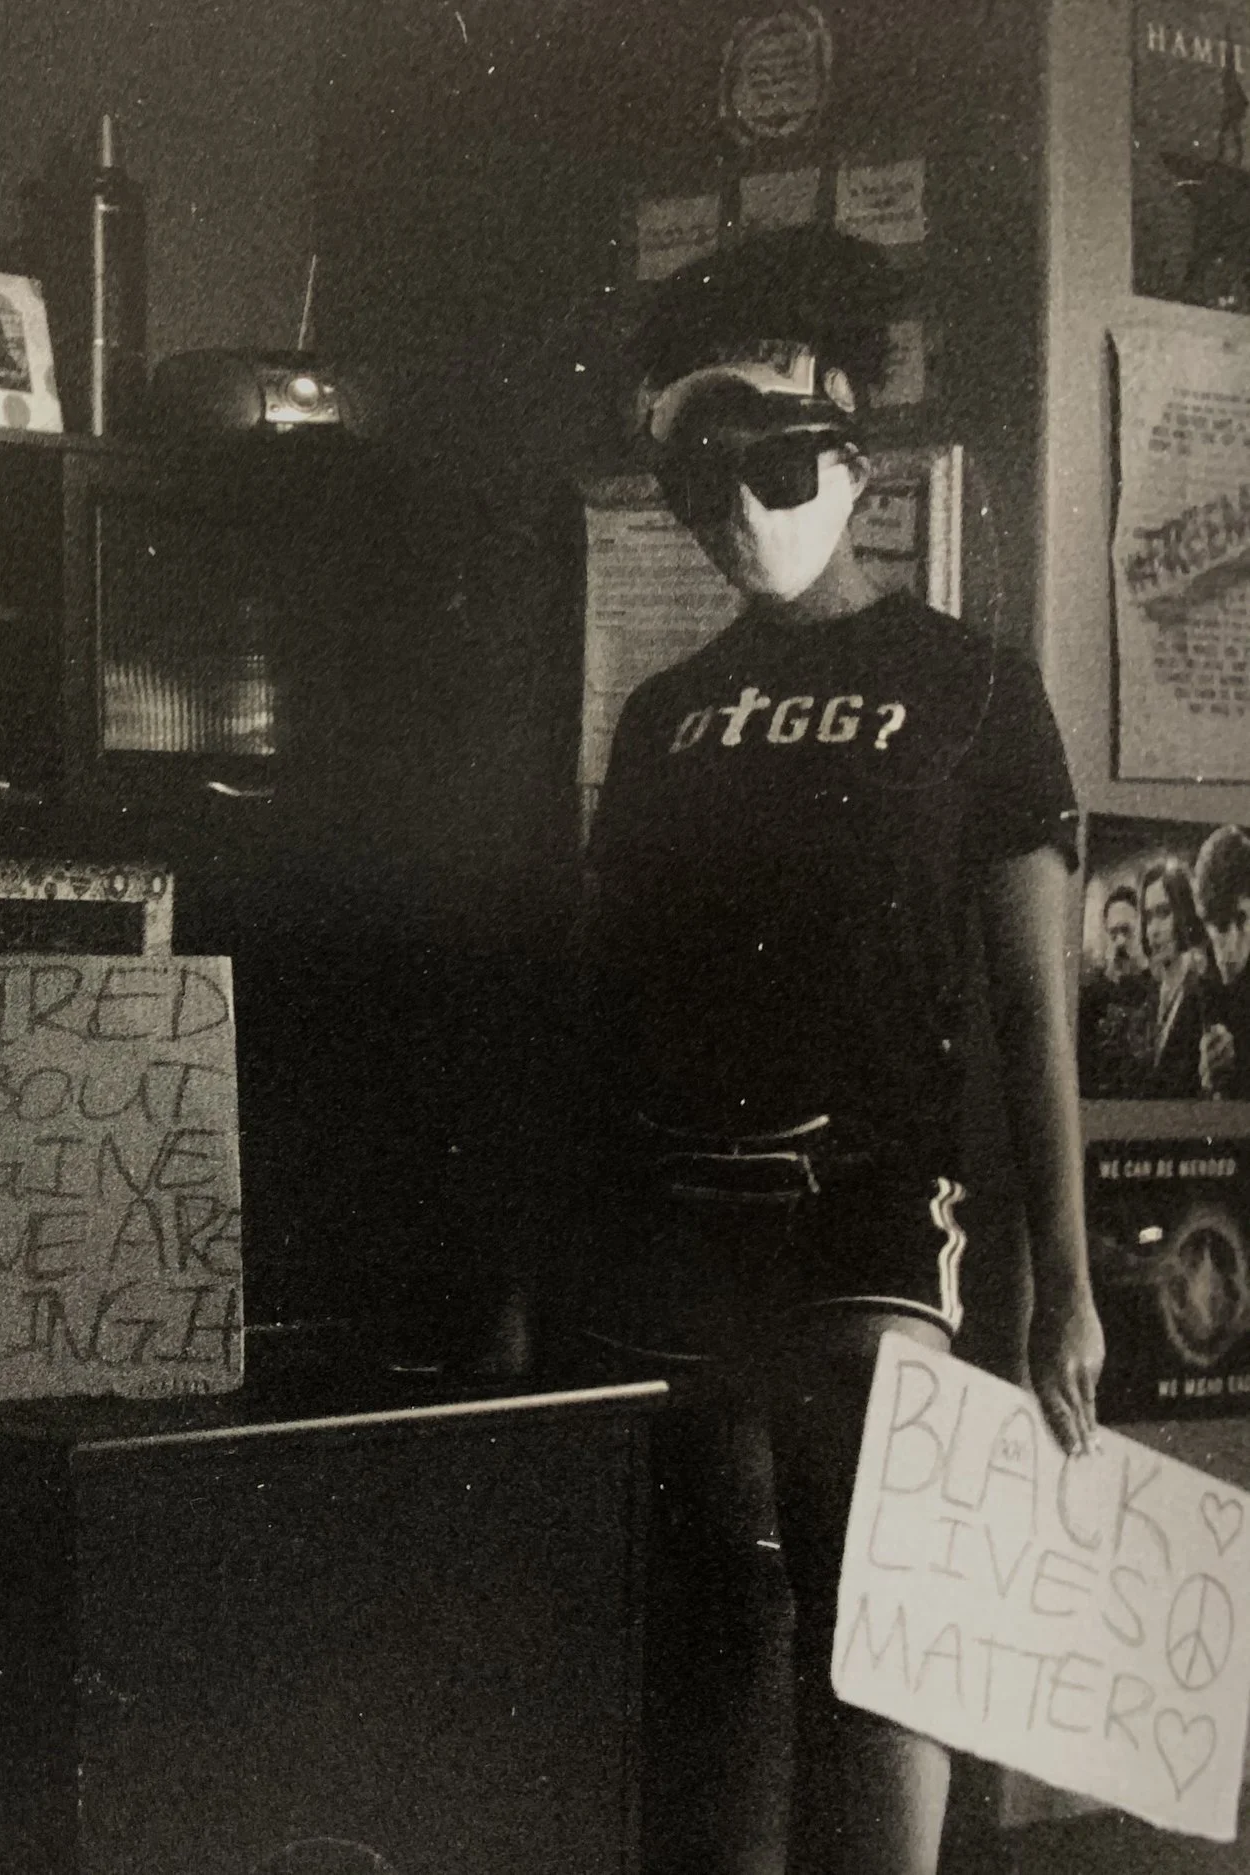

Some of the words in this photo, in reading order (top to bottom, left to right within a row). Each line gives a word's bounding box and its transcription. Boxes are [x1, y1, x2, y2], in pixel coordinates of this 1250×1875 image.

[108, 1194, 241, 1278] ARE
[881, 1359, 1173, 1572] BLACK
[867, 1492, 1147, 1649] LIVES
[839, 1591, 1156, 1751] MATTER
